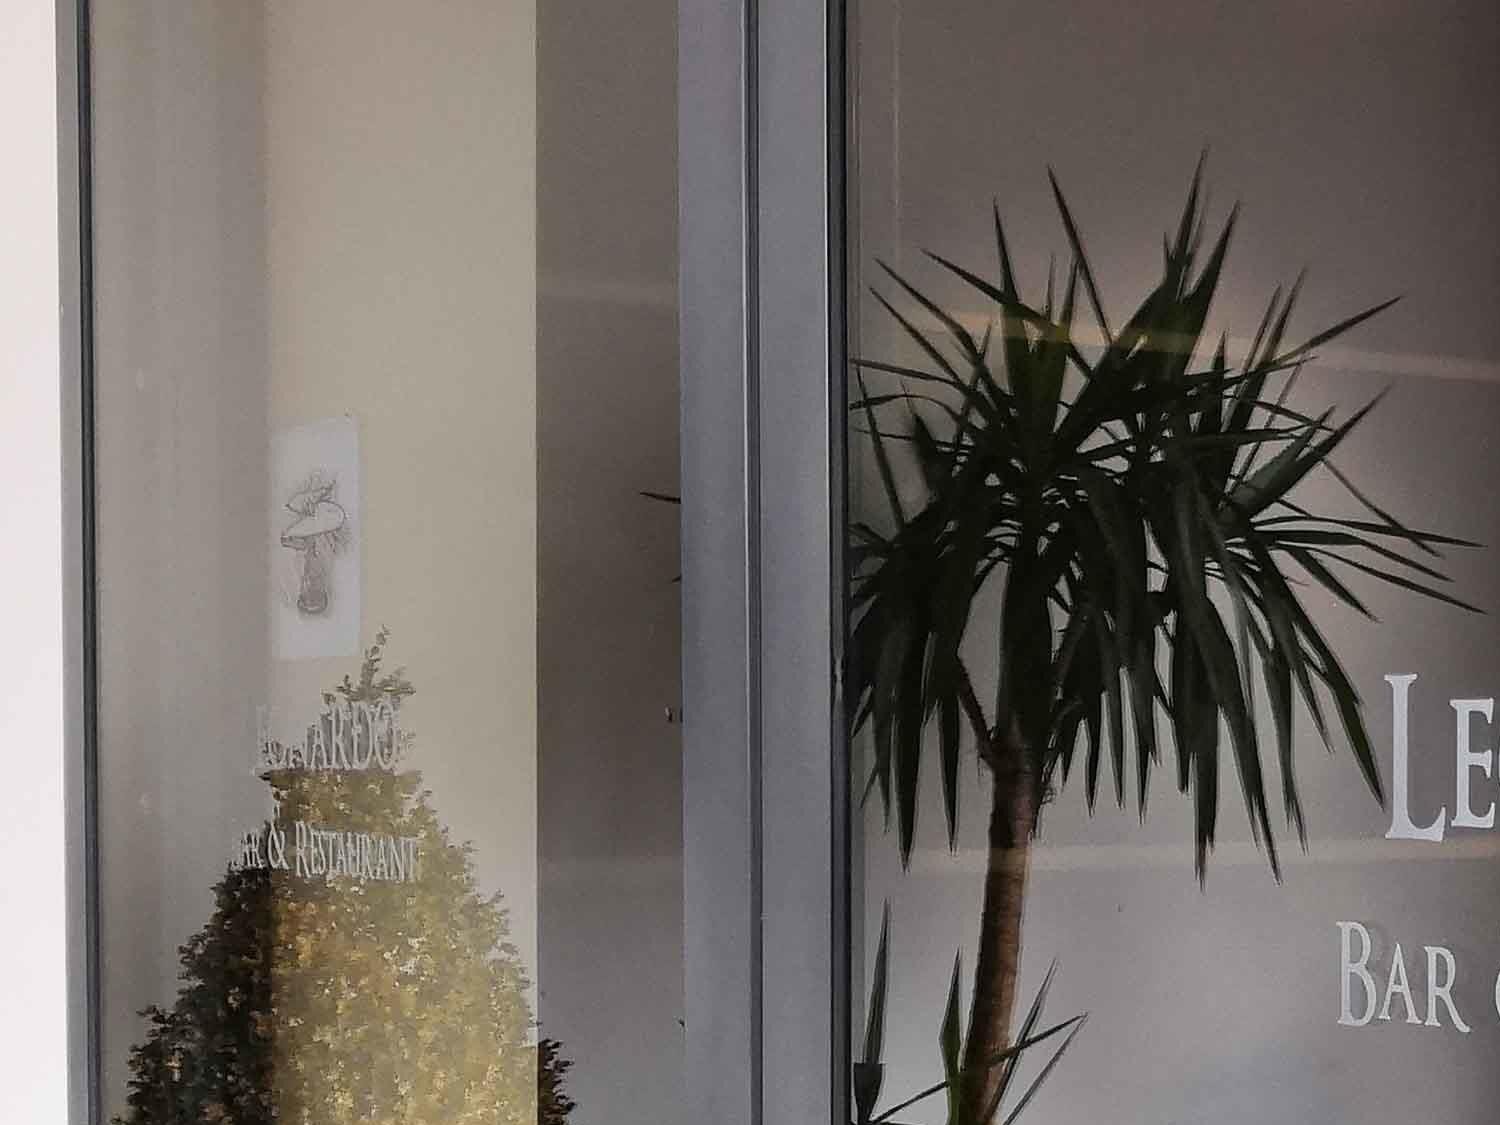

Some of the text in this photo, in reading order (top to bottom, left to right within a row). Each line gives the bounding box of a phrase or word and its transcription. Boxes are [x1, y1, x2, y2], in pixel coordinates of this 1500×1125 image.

[268, 800, 290, 870] &
[295, 820, 420, 882] RESTAURANT
[1337, 920, 1471, 1034] BAR
